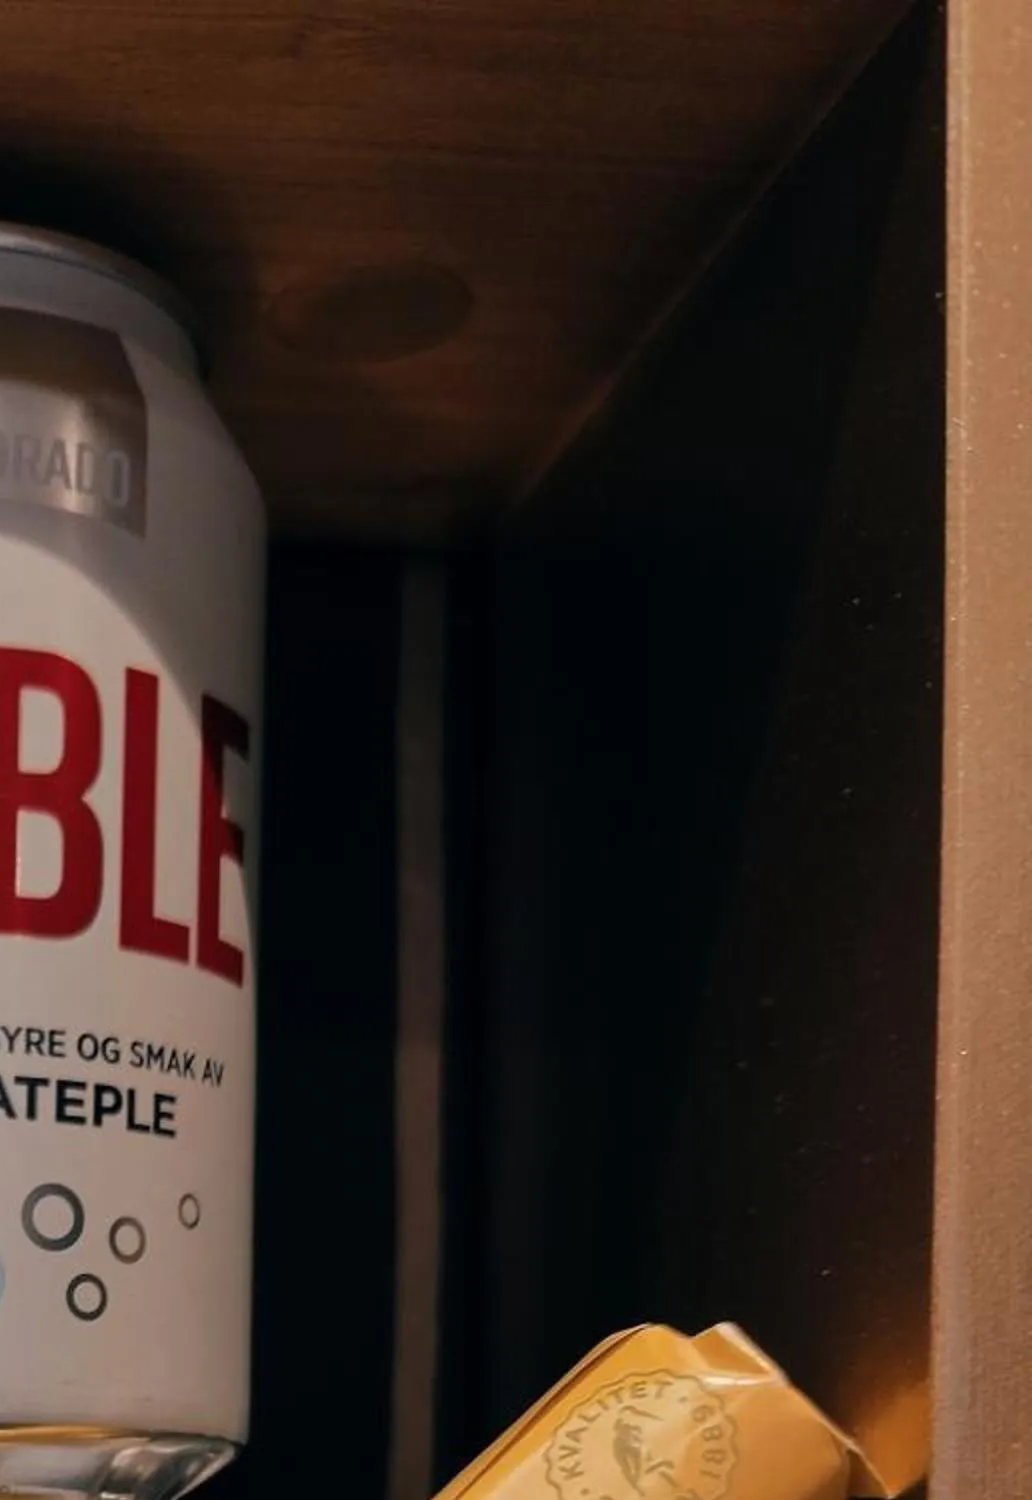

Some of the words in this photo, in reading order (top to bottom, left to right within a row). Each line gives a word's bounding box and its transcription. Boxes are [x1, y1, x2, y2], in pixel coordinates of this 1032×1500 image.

[76, 1032, 121, 1066] OG
[130, 1041, 196, 1080] SMAK
[201, 1053, 226, 1088] AV
[558, 1378, 674, 1481] KVALITET
